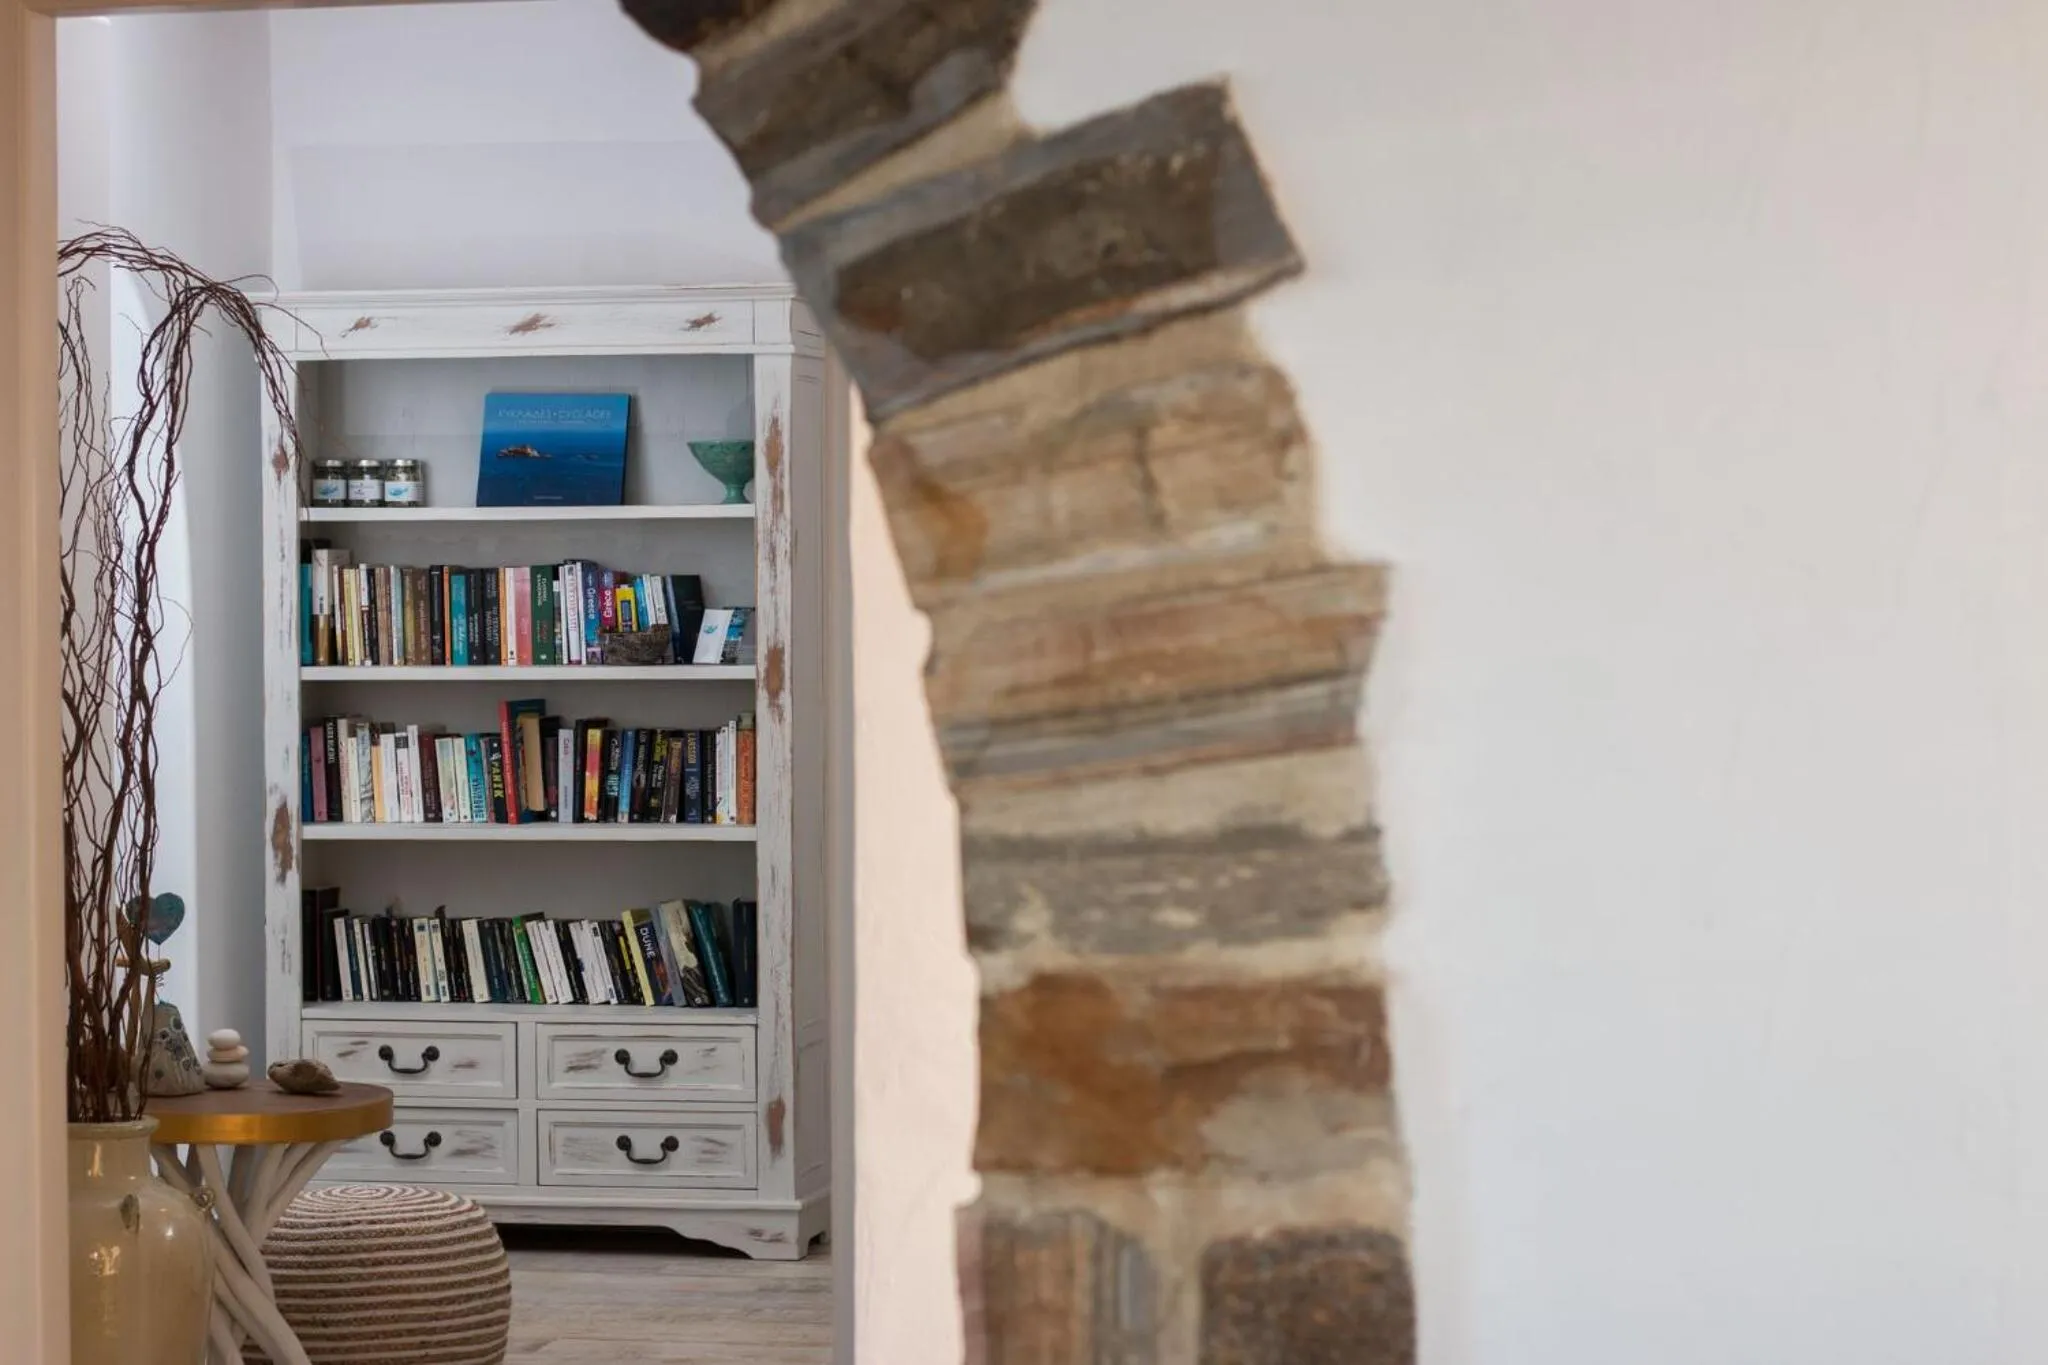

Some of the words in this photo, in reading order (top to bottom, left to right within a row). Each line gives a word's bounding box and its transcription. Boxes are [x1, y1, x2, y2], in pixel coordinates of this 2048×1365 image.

[587, 587, 597, 620] Greece
[491, 761, 504, 799] PANIK
[639, 926, 656, 959] DUNE
